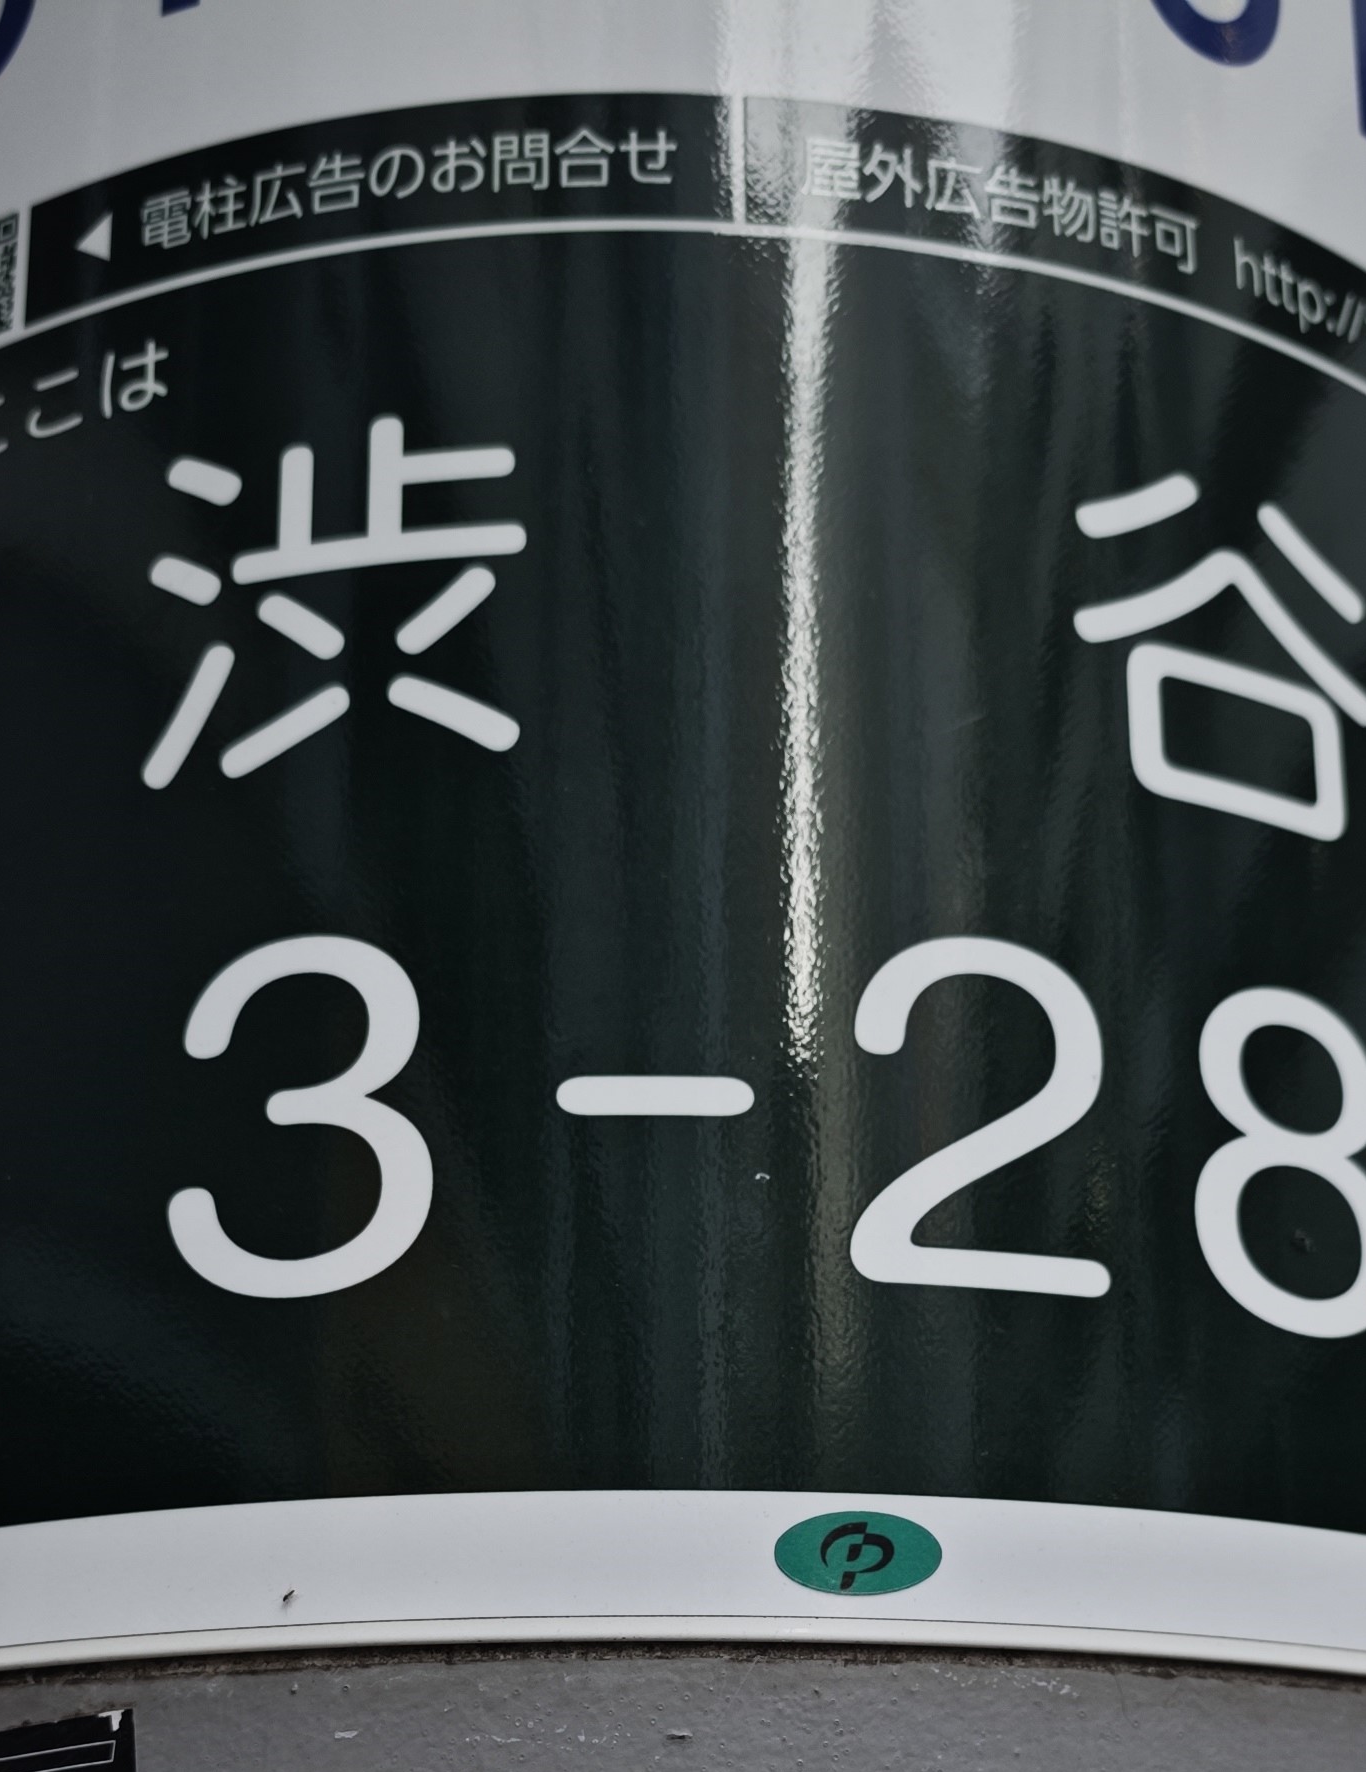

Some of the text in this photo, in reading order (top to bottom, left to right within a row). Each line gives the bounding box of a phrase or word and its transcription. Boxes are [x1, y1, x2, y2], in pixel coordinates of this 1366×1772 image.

[140, 129, 678, 250] 電柱広告のお問合せ
[801, 137, 1199, 274] 屋外広告物許可
